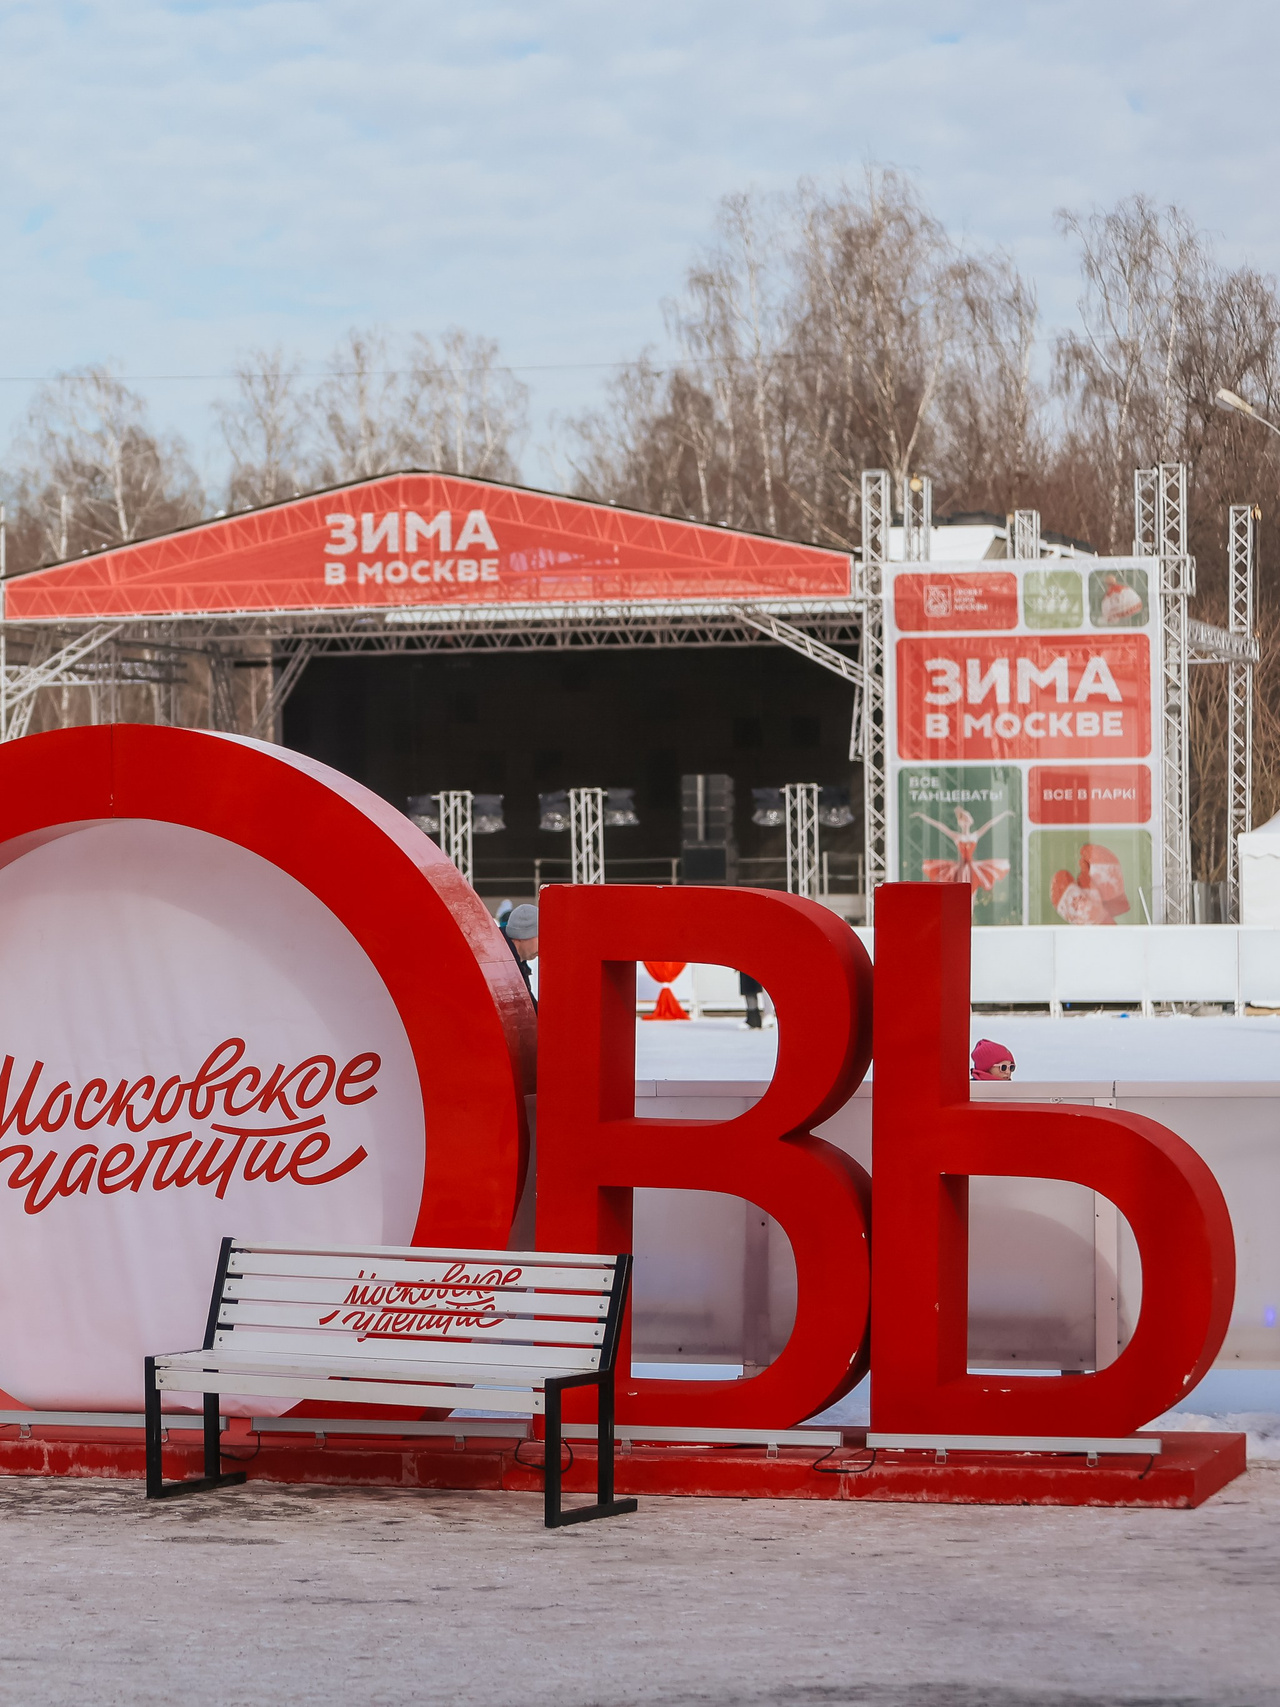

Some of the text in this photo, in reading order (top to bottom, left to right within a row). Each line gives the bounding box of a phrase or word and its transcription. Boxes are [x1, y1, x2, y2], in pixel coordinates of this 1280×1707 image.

[324, 510, 499, 555] ЗИМА
[325, 559, 499, 585] В МОСКВЕ
[924, 657, 1123, 706] ЗИМА
[925, 711, 1124, 739] В МОСКВЕ
[909, 776, 940, 789] ВСЕ
[909, 789, 1003, 802] ТАНЦЕВАТЬ!
[1043, 787, 1137, 801] ВСЕ В ПАРК!
[318, 1263, 523, 1325] Московское
